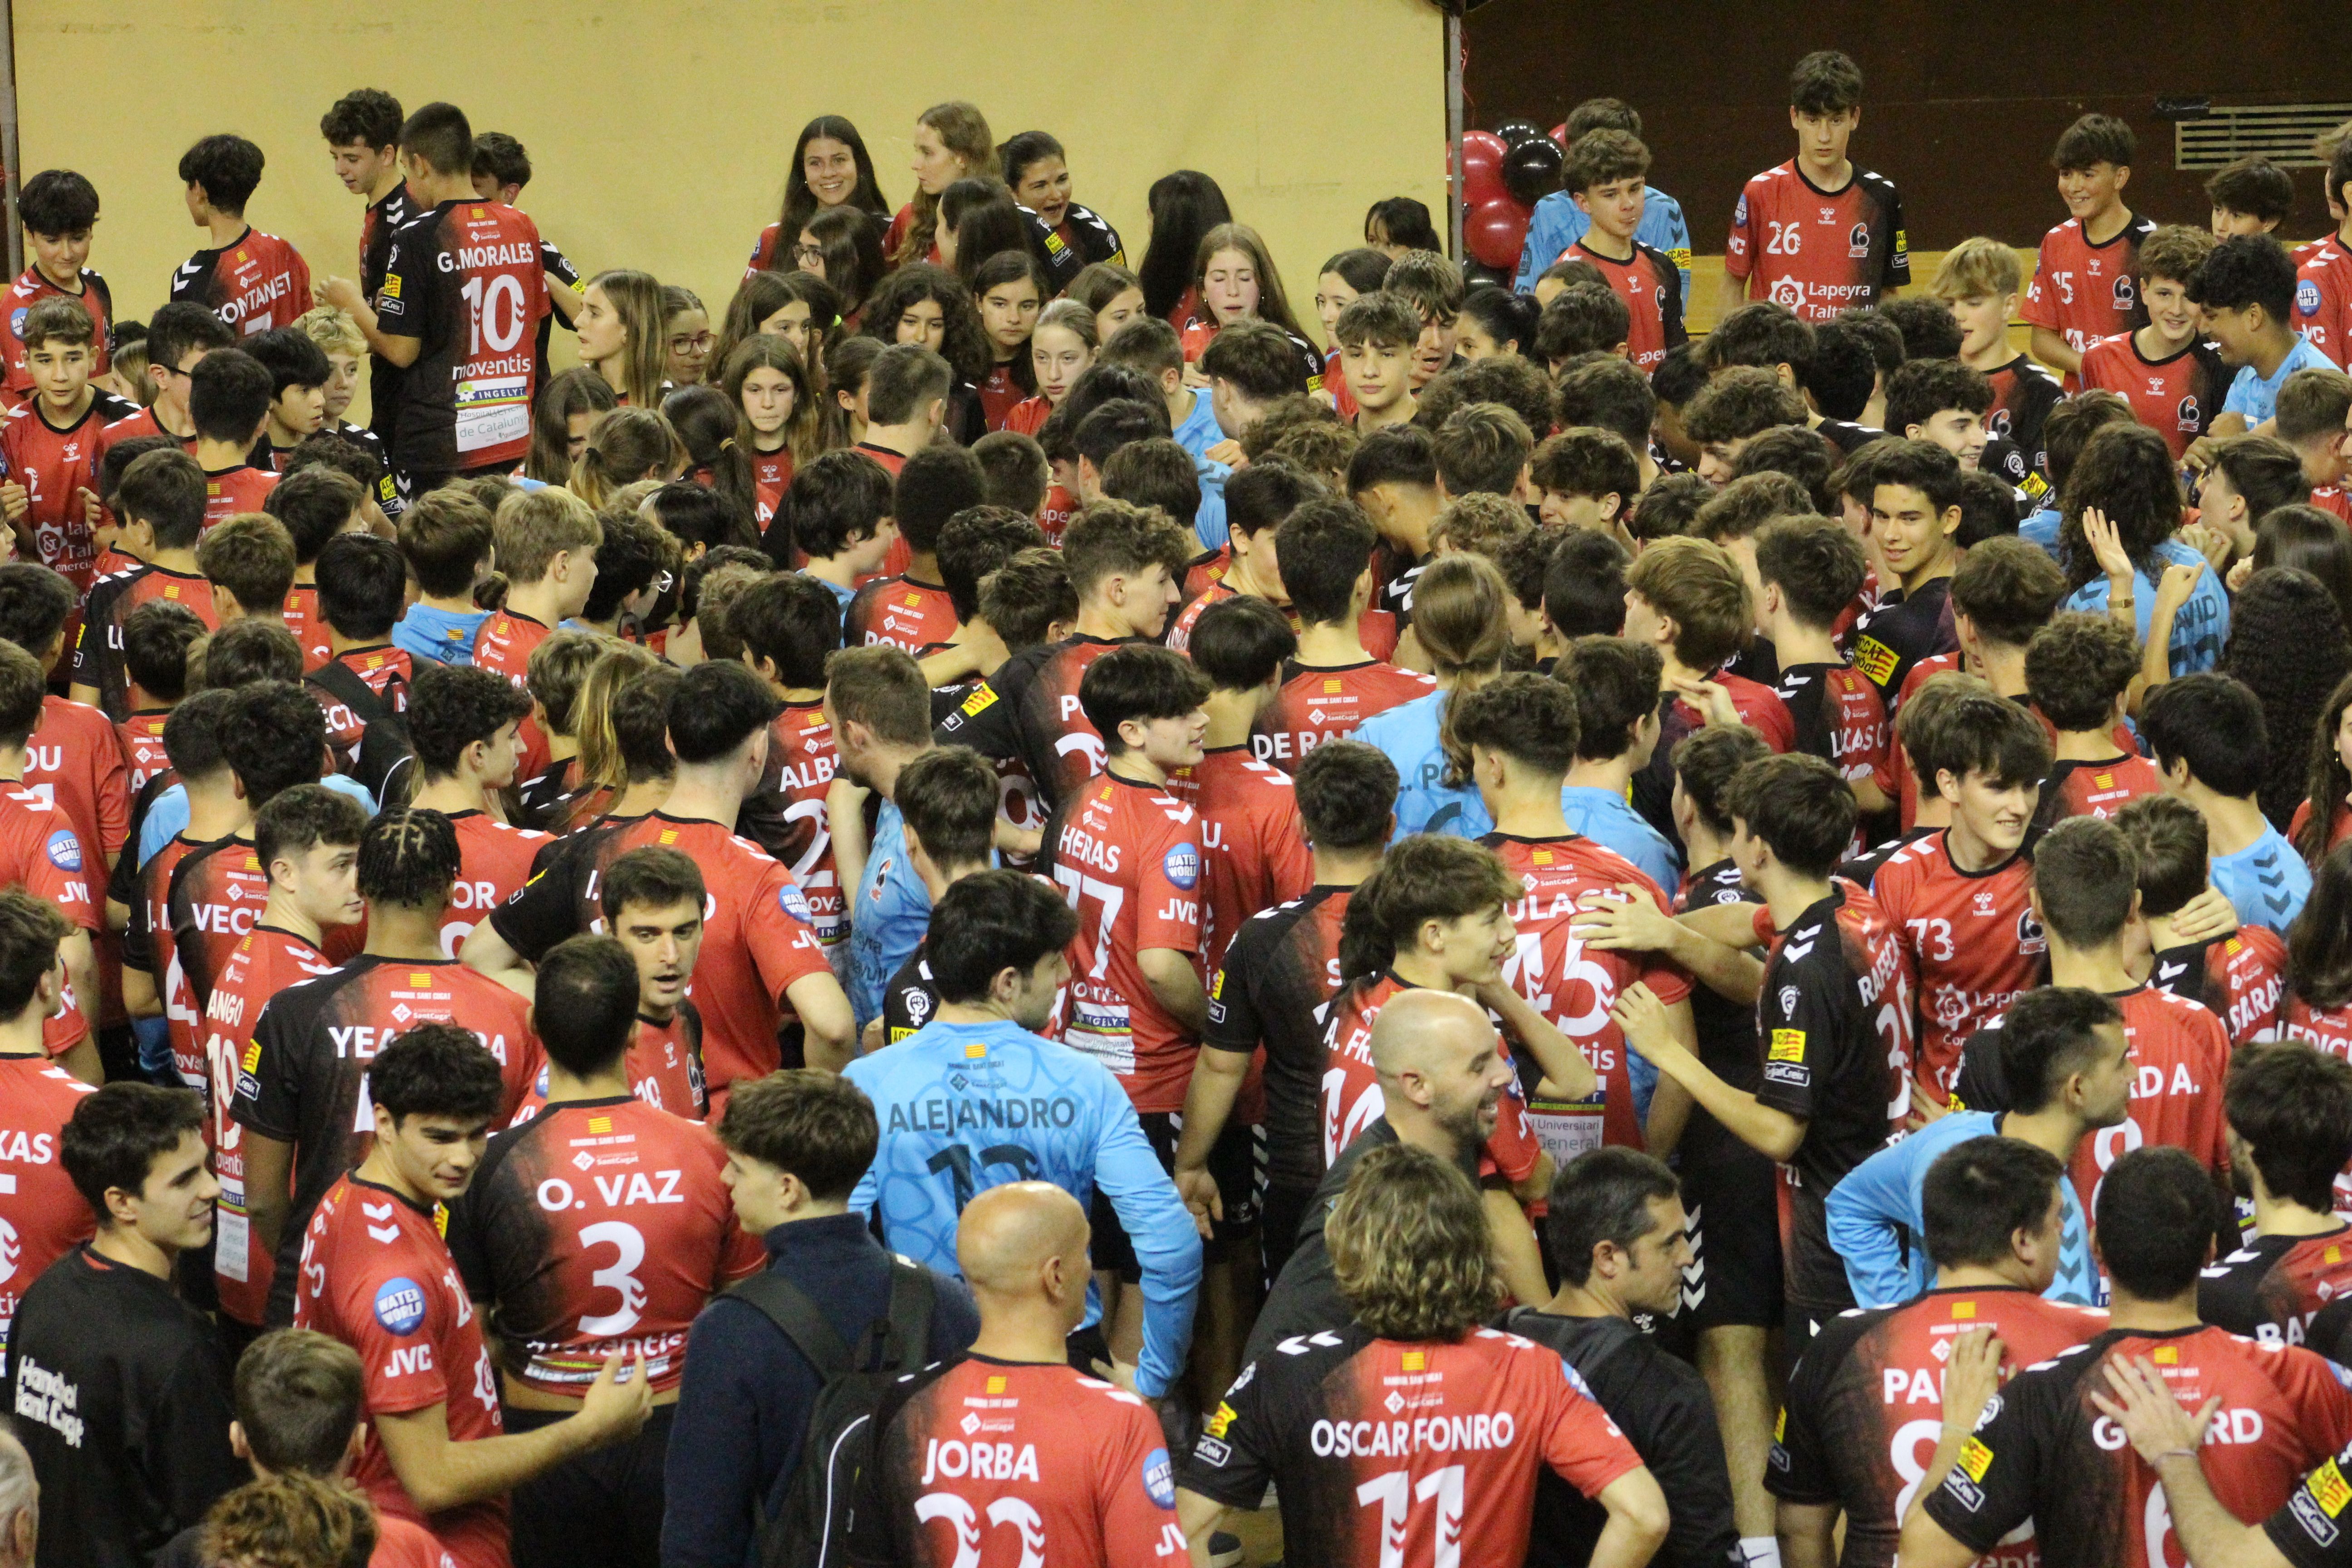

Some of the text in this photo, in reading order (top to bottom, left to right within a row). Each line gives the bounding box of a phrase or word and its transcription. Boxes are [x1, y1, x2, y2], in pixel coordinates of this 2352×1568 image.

[1767, 221, 1801, 255] 26
[1808, 282, 1870, 300] Lapeyra
[461, 274, 525, 356] 10
[453, 353, 532, 380] moventis
[478, 387, 524, 400] INGELYT
[459, 427, 475, 438] de
[1254, 732, 1293, 760] DE
[1058, 824, 1121, 874] HERAS
[1540, 877, 1578, 887] SantCugat
[1054, 862, 1123, 981] 77
[1158, 898, 1197, 926] JVC
[1905, 917, 1955, 961] 73
[2170, 1063, 2201, 1095] A.
[887, 1096, 1076, 1137] ALEJANDRO
[1538, 1120, 1599, 1131] Universitari
[537, 1169, 684, 1212] O. VAZ
[577, 1220, 648, 1336] 3
[377, 1288, 420, 1315] WATER
[381, 1301, 424, 1326] WORLD
[384, 1343, 432, 1378] JVC
[921, 1438, 1040, 1485] JORBA
[1356, 1464, 1465, 1568] 11
